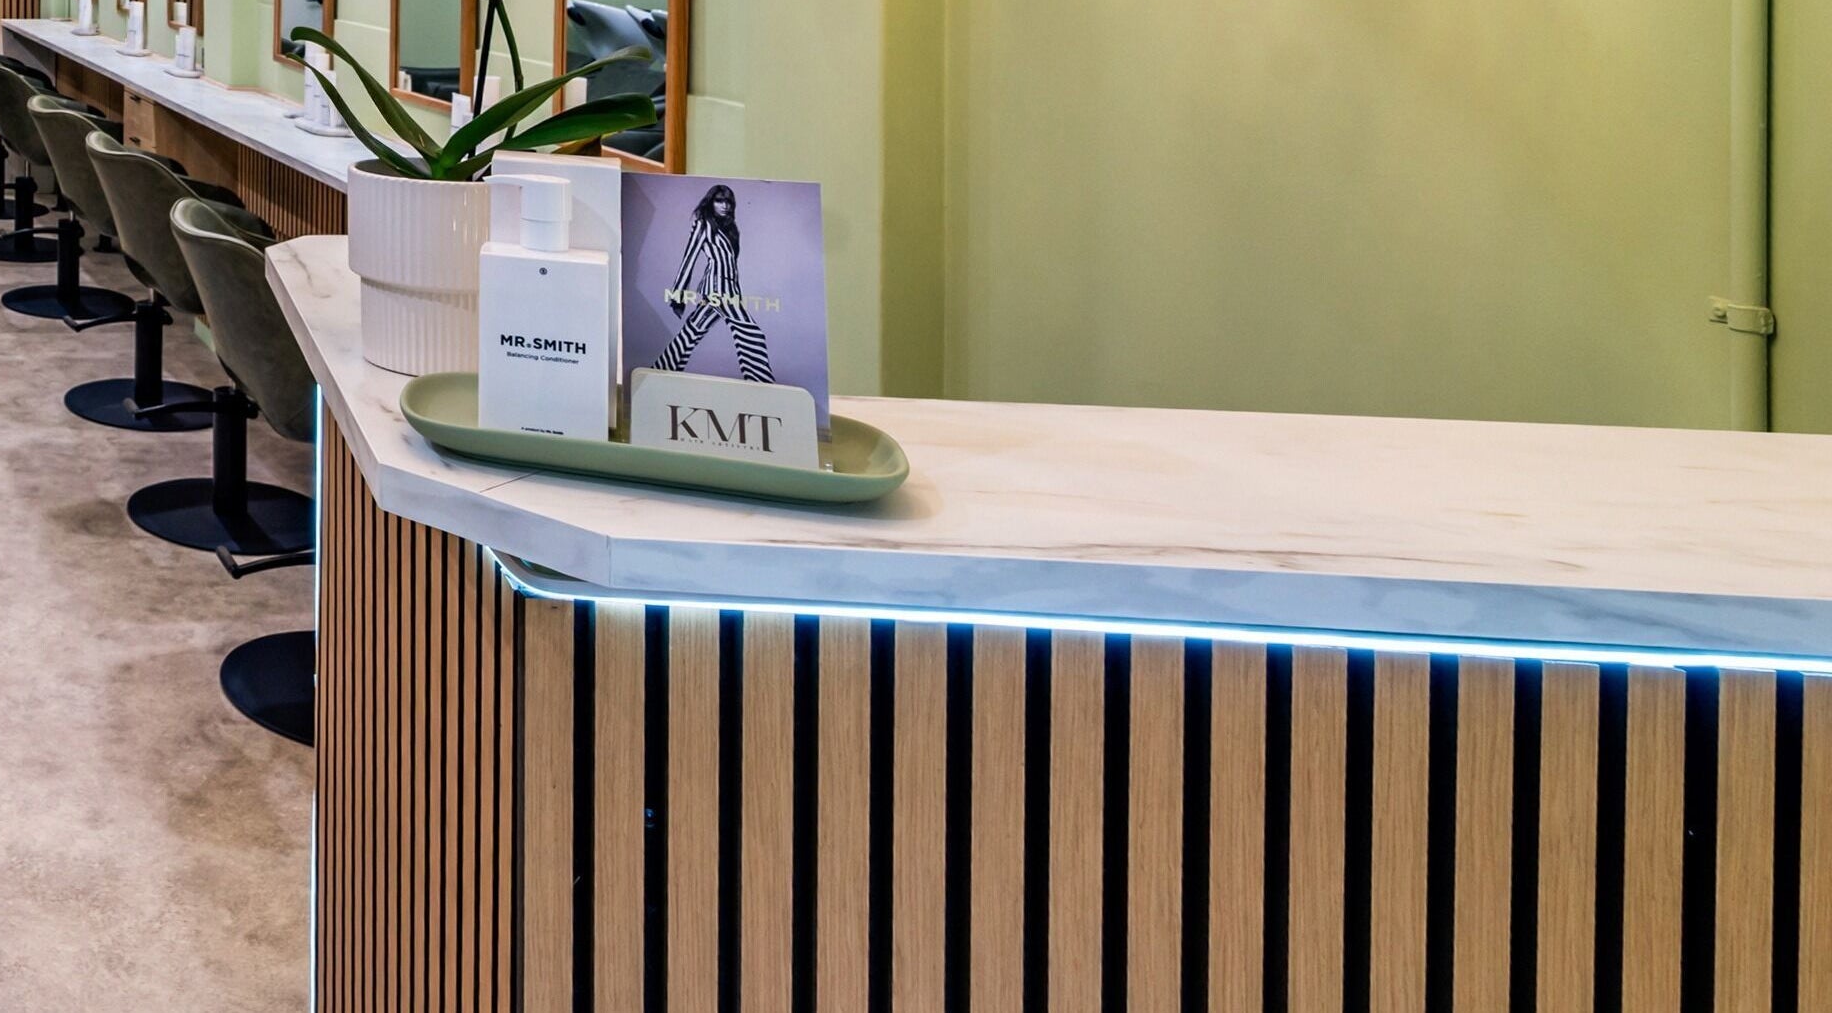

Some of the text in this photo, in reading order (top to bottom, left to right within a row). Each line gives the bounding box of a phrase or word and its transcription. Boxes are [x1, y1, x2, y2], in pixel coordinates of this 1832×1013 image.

[506, 351, 579, 365] Balancing Conditioner
[665, 404, 783, 453] KMT
